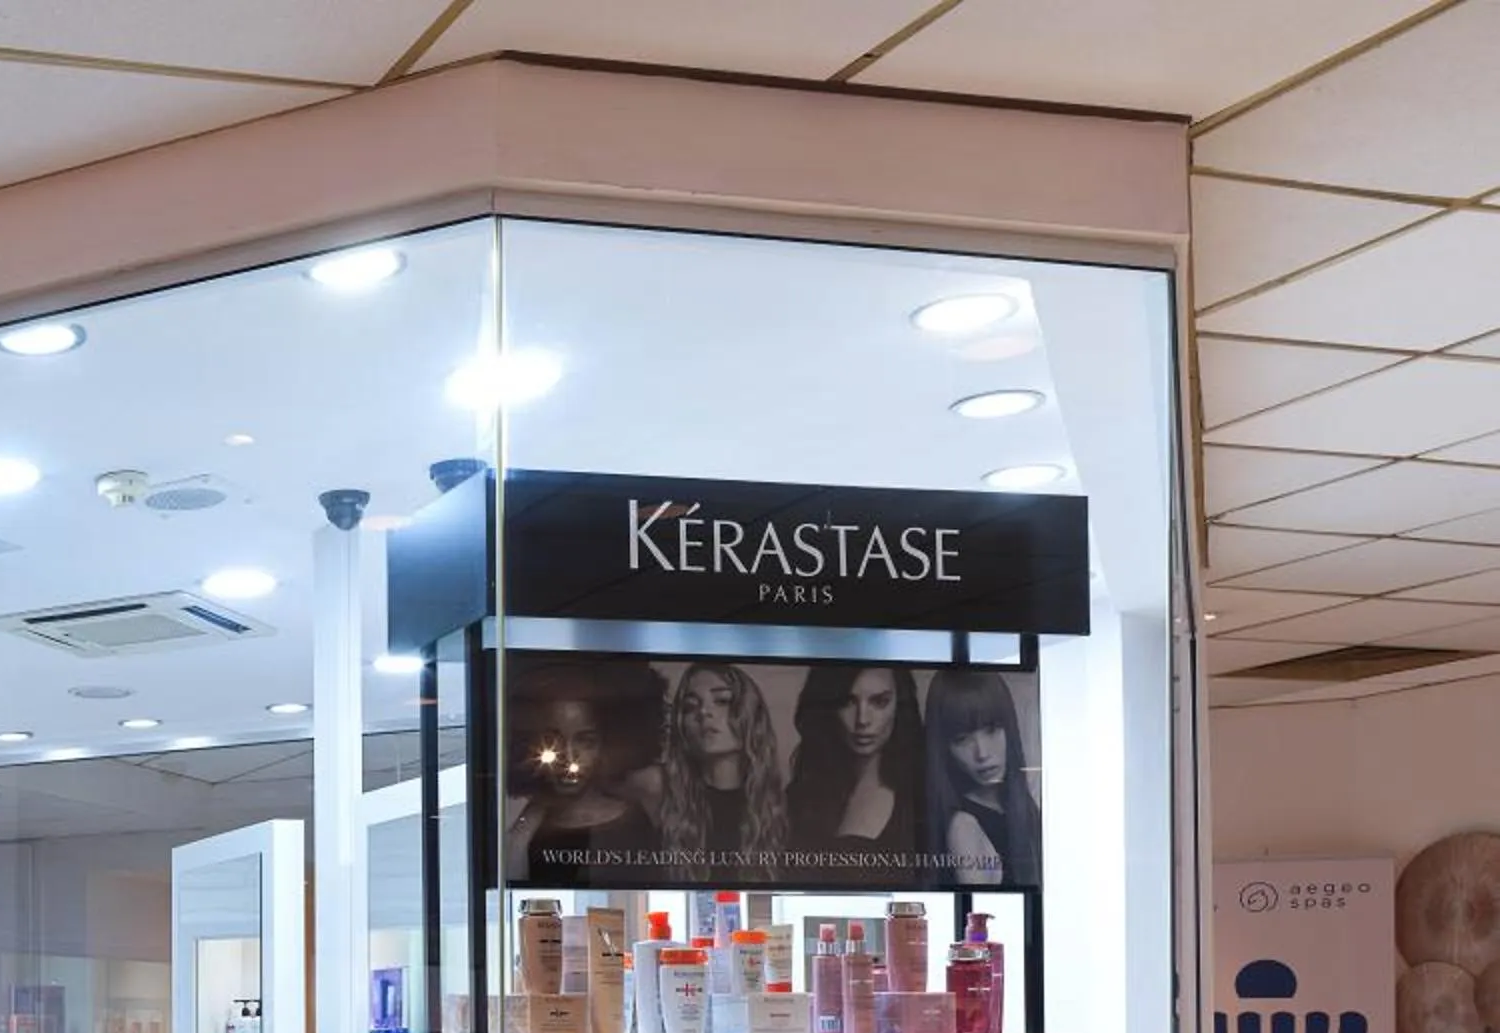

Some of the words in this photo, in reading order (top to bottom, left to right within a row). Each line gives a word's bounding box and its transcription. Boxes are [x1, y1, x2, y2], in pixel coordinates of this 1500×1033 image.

[629, 499, 961, 581] KÉRASTASE
[758, 584, 834, 604] PARIS
[542, 849, 622, 864] WORLD'S
[626, 850, 705, 865] LEADING
[710, 850, 779, 866] LUXURY
[785, 851, 912, 868] PROFESSIONAL
[1290, 883, 1371, 896] aegeo
[1290, 897, 1346, 909] spas
